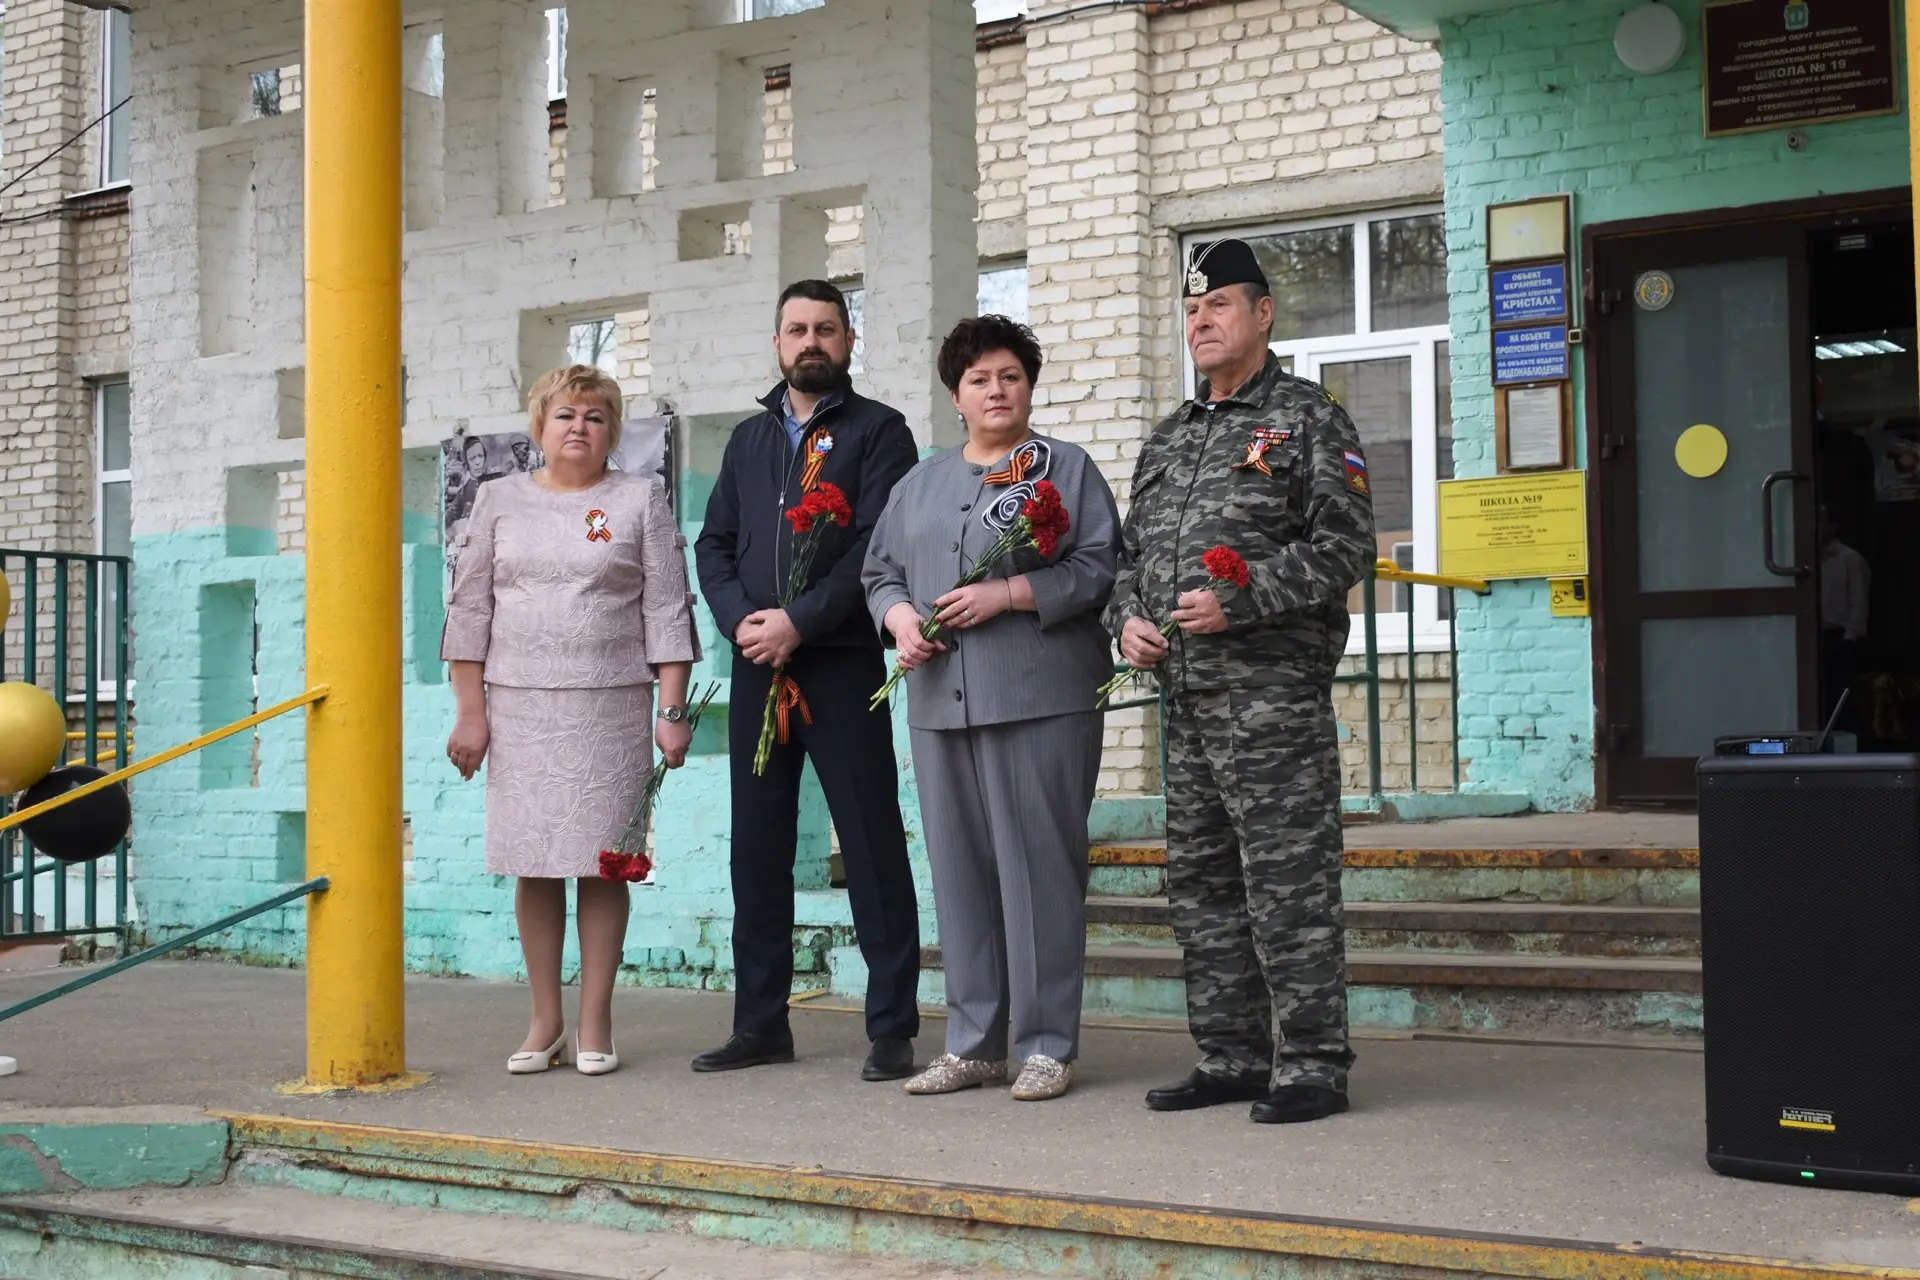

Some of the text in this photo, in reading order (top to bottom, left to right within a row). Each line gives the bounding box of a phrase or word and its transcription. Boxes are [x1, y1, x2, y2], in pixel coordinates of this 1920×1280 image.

[1738, 35, 1787, 49] ГОРОДСКОЙ
[1788, 31, 1814, 42] ОКРУГ
[1734, 37, 1863, 62] МУНИЦИПАЛЬНОЕ БЮДЖЕТНОЕ
[1821, 45, 1877, 60] УЧРЕЖДЕНИЕ
[1755, 59, 1847, 81] ШКОЛА № 19
[1737, 70, 1862, 93] ГОРОДСКОГО ОКРУГА КИНЕШМА
[1712, 97, 1741, 107] ИМЕНИ
[1757, 94, 1842, 112] СТРЕЛКОВОГО ПОЛКА
[1763, 109, 1816, 124] ИВАНОВСКОЙ
[1817, 104, 1857, 116] ДИВИЗИИ
[1511, 271, 1542, 281] ОБЪЕКТ
[1503, 278, 1553, 291] ОХРАНЯЕТСЯ
[1502, 295, 1557, 310] КРИСТАЛЛ
[1509, 331, 1552, 343] НА ОБЪЕКТЕ
[1495, 340, 1566, 355] ПРОПУСКНОЙ РЕЖИМ
[1507, 358, 1536, 367] ОБЪЕКТЕ
[1497, 364, 1564, 379] ВИДЕОНАБЛЮДЕНИЕ
[1480, 494, 1543, 507] ШКОЛА №19
